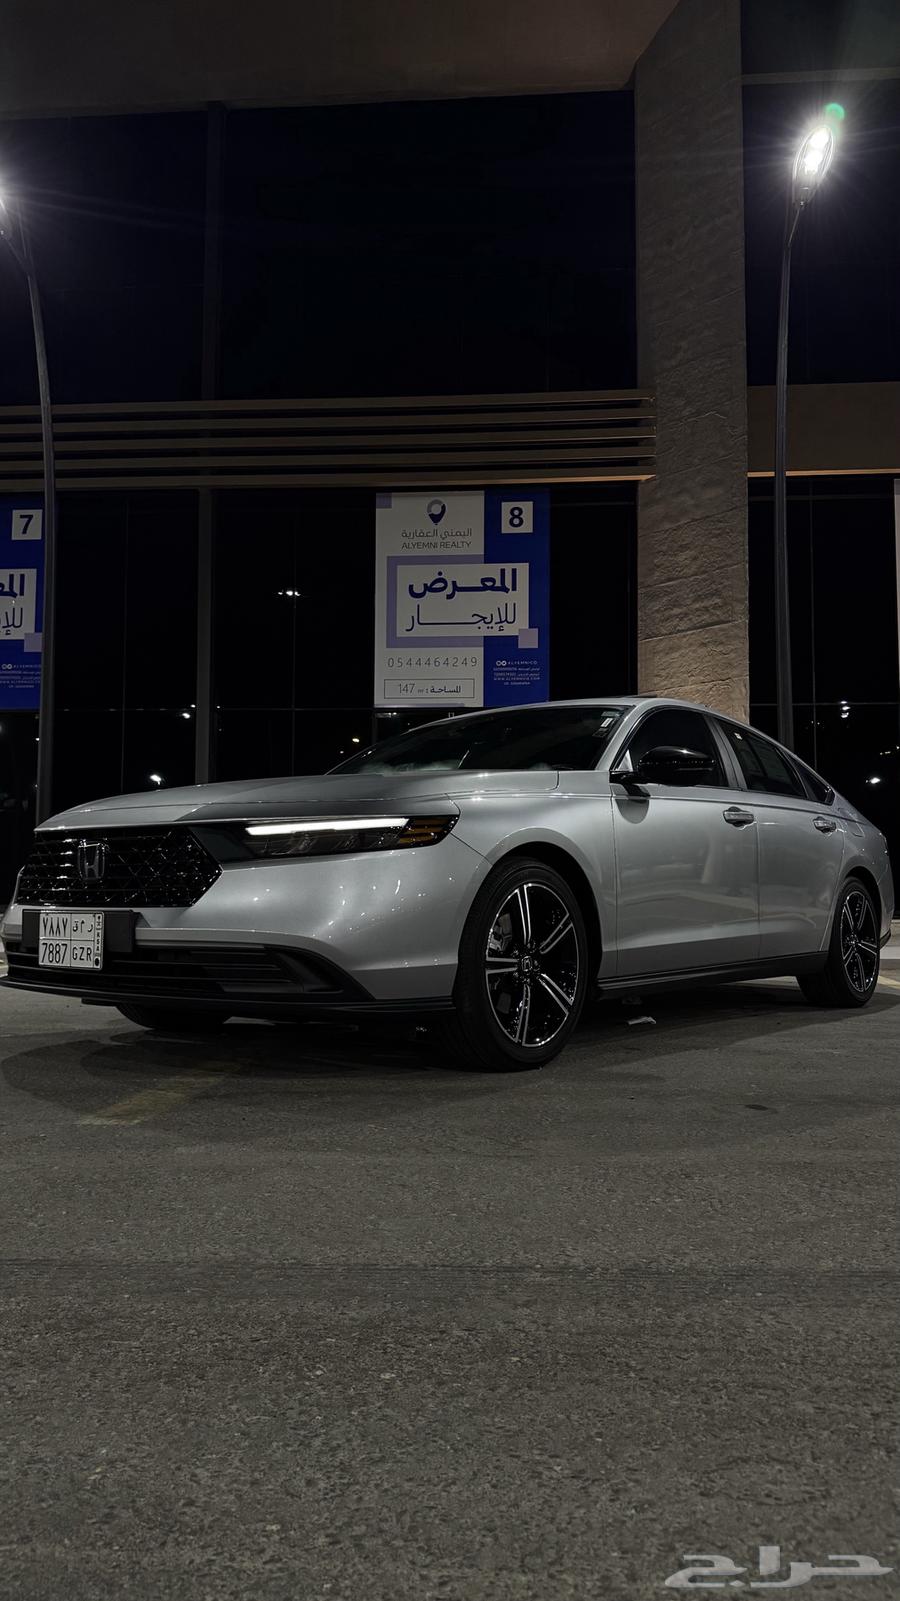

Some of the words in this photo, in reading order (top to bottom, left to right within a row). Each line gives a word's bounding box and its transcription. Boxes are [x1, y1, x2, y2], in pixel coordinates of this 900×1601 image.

[19, 514, 34, 535] 7
[508, 506, 524, 528] 8
[401, 528, 438, 540] العقارية
[440, 528, 472, 541] اليمني
[401, 541, 438, 550] ALYEMNI
[440, 541, 472, 549] REALTY
[408, 567, 518, 600] المعرض
[405, 602, 517, 632] للإيجار
[387, 656, 478, 668] 0544464249
[398, 683, 416, 694] 147
[42, 916, 68, 938] ٧٨٨٧
[41, 942, 68, 964] 7887
[72, 946, 92, 961] GZR
